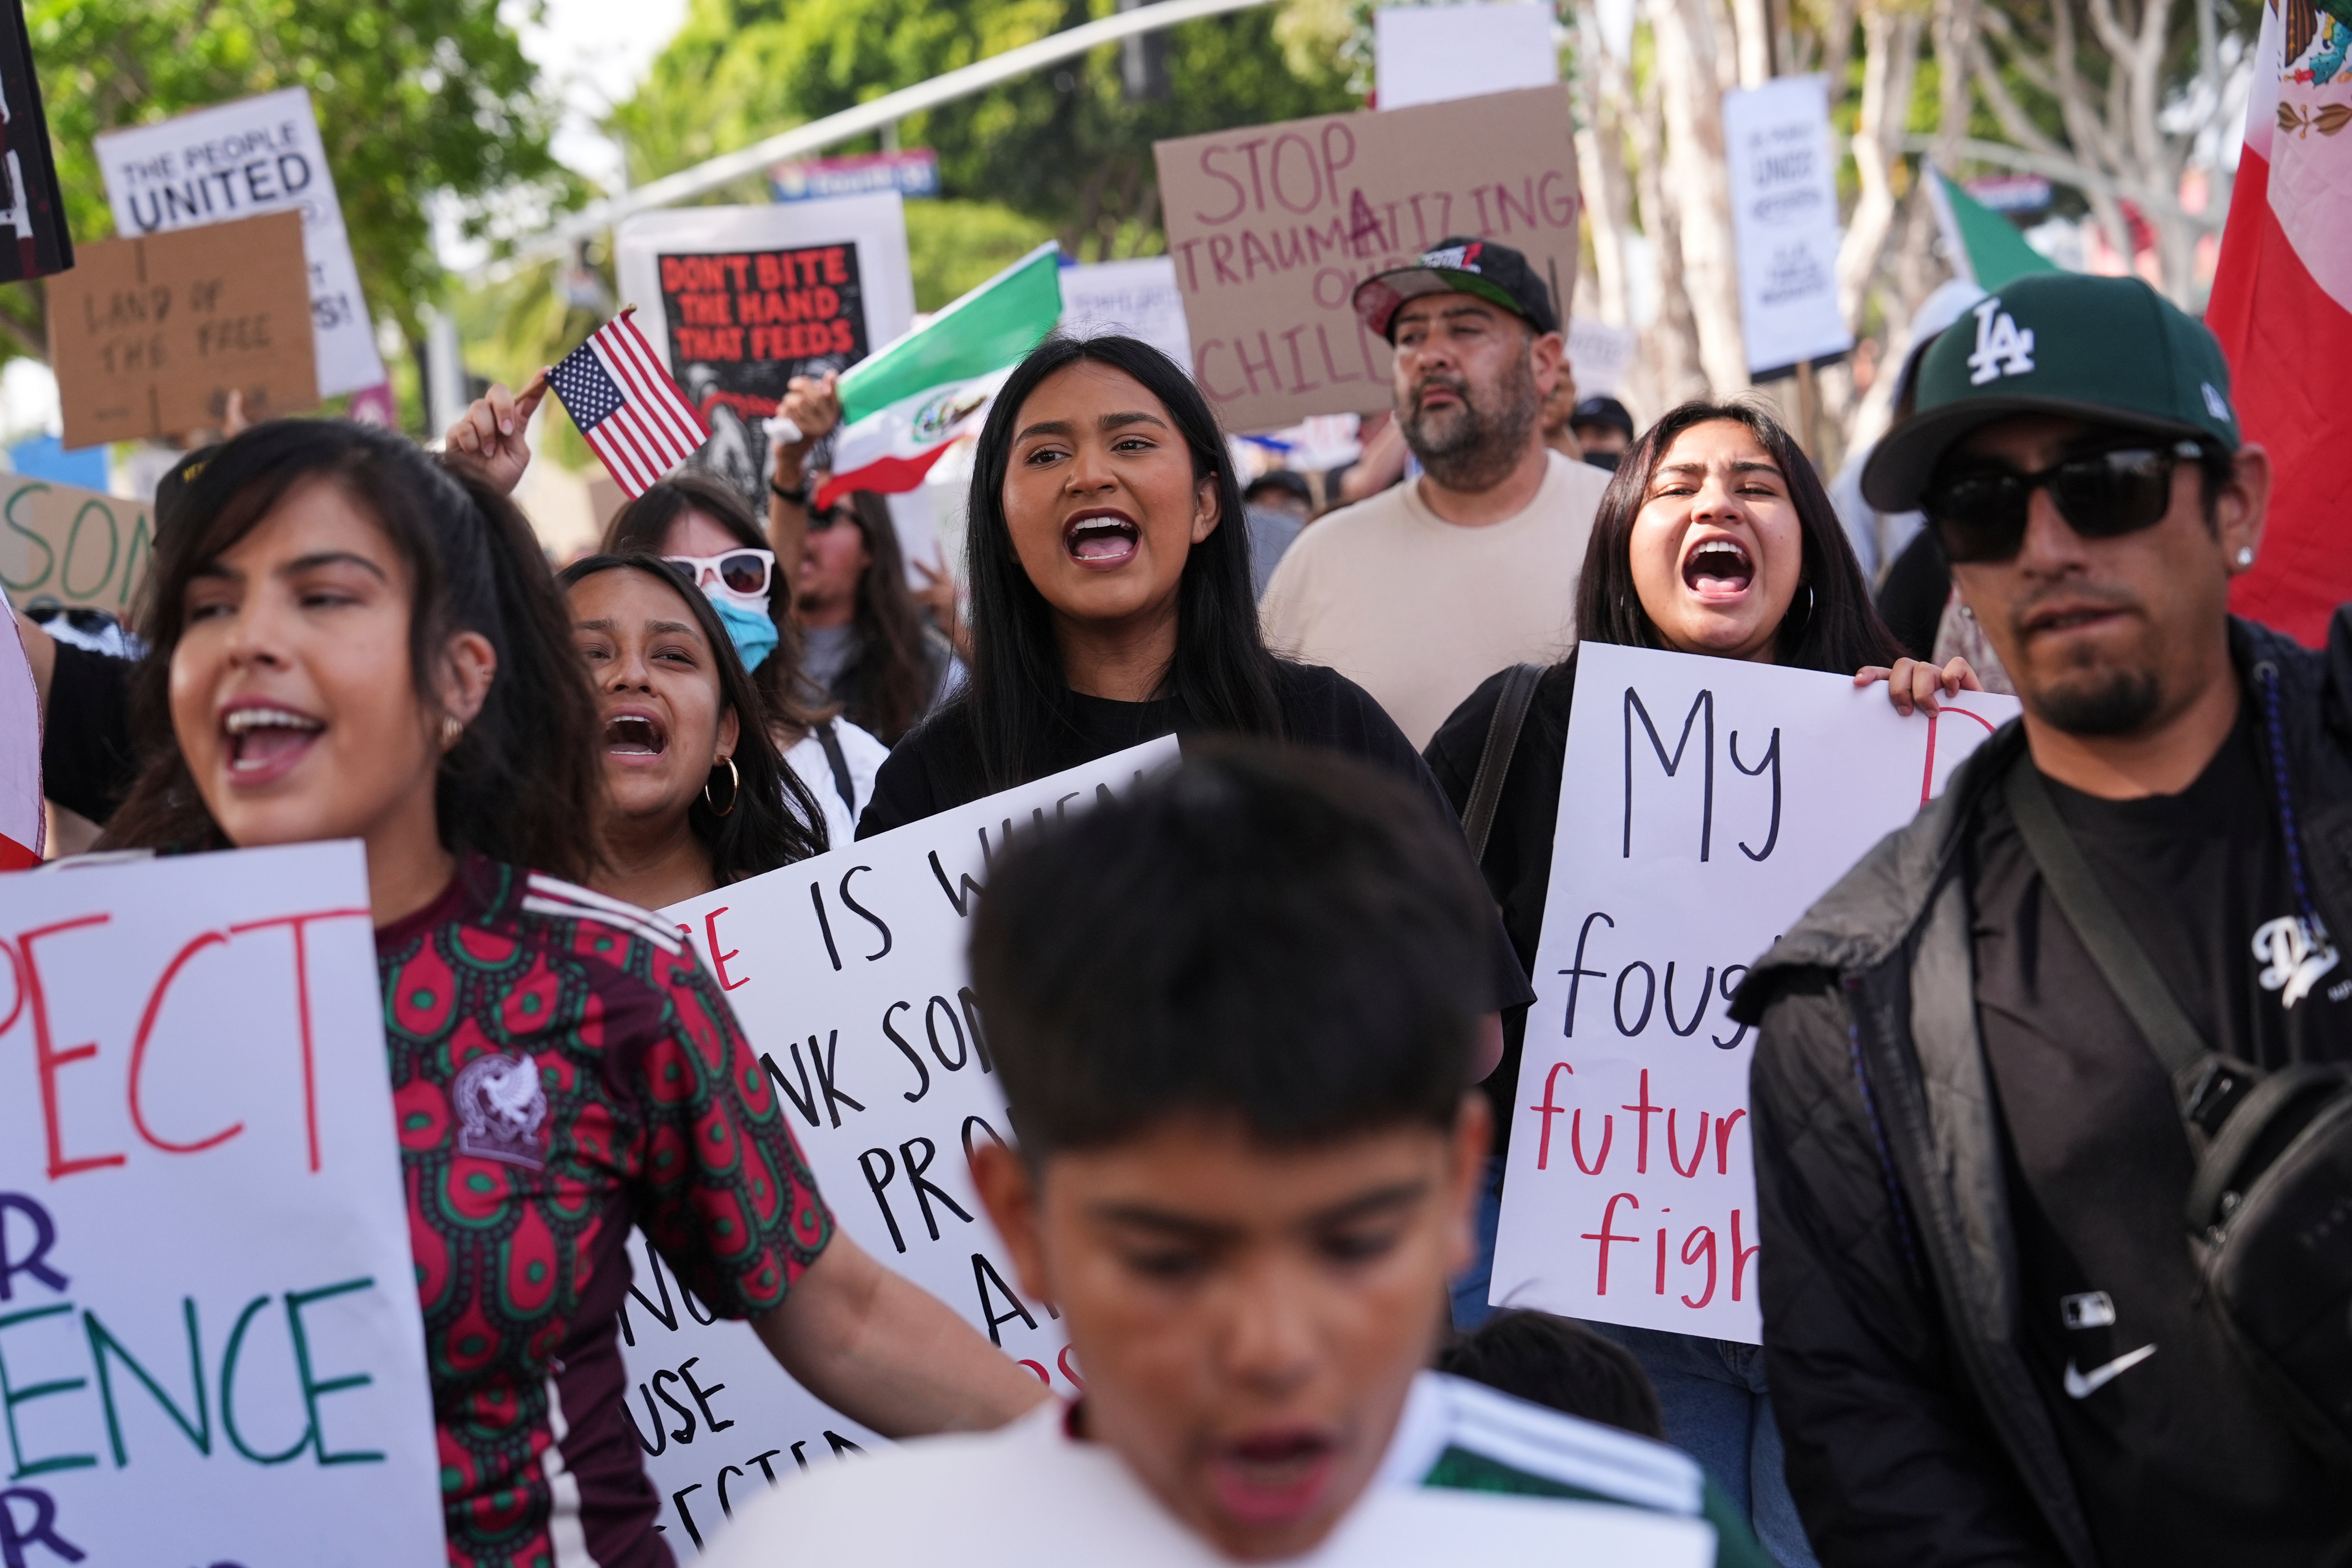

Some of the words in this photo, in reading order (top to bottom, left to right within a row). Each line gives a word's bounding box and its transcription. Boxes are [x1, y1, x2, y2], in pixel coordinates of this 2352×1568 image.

[121, 154, 178, 187] THE
[184, 121, 300, 170] PEOPLE
[128, 154, 312, 232] UNITED
[1194, 121, 1357, 226] STOP
[84, 281, 172, 334] LAND
[189, 277, 224, 314] OF
[661, 254, 751, 293] DON'T
[755, 245, 849, 291] BITE
[677, 290, 733, 326] THE
[737, 285, 840, 325] HAND
[100, 333, 166, 375] THE
[197, 314, 274, 357] FREE
[673, 325, 744, 362] THAT
[749, 318, 855, 362] FEEDS
[1967, 296, 2035, 386] LA
[1624, 686, 1781, 862] My
[810, 866, 893, 971] IS
[1558, 912, 1782, 1050] foug
[1530, 1062, 1746, 1178] futur
[971, 1253, 1060, 1349] A
